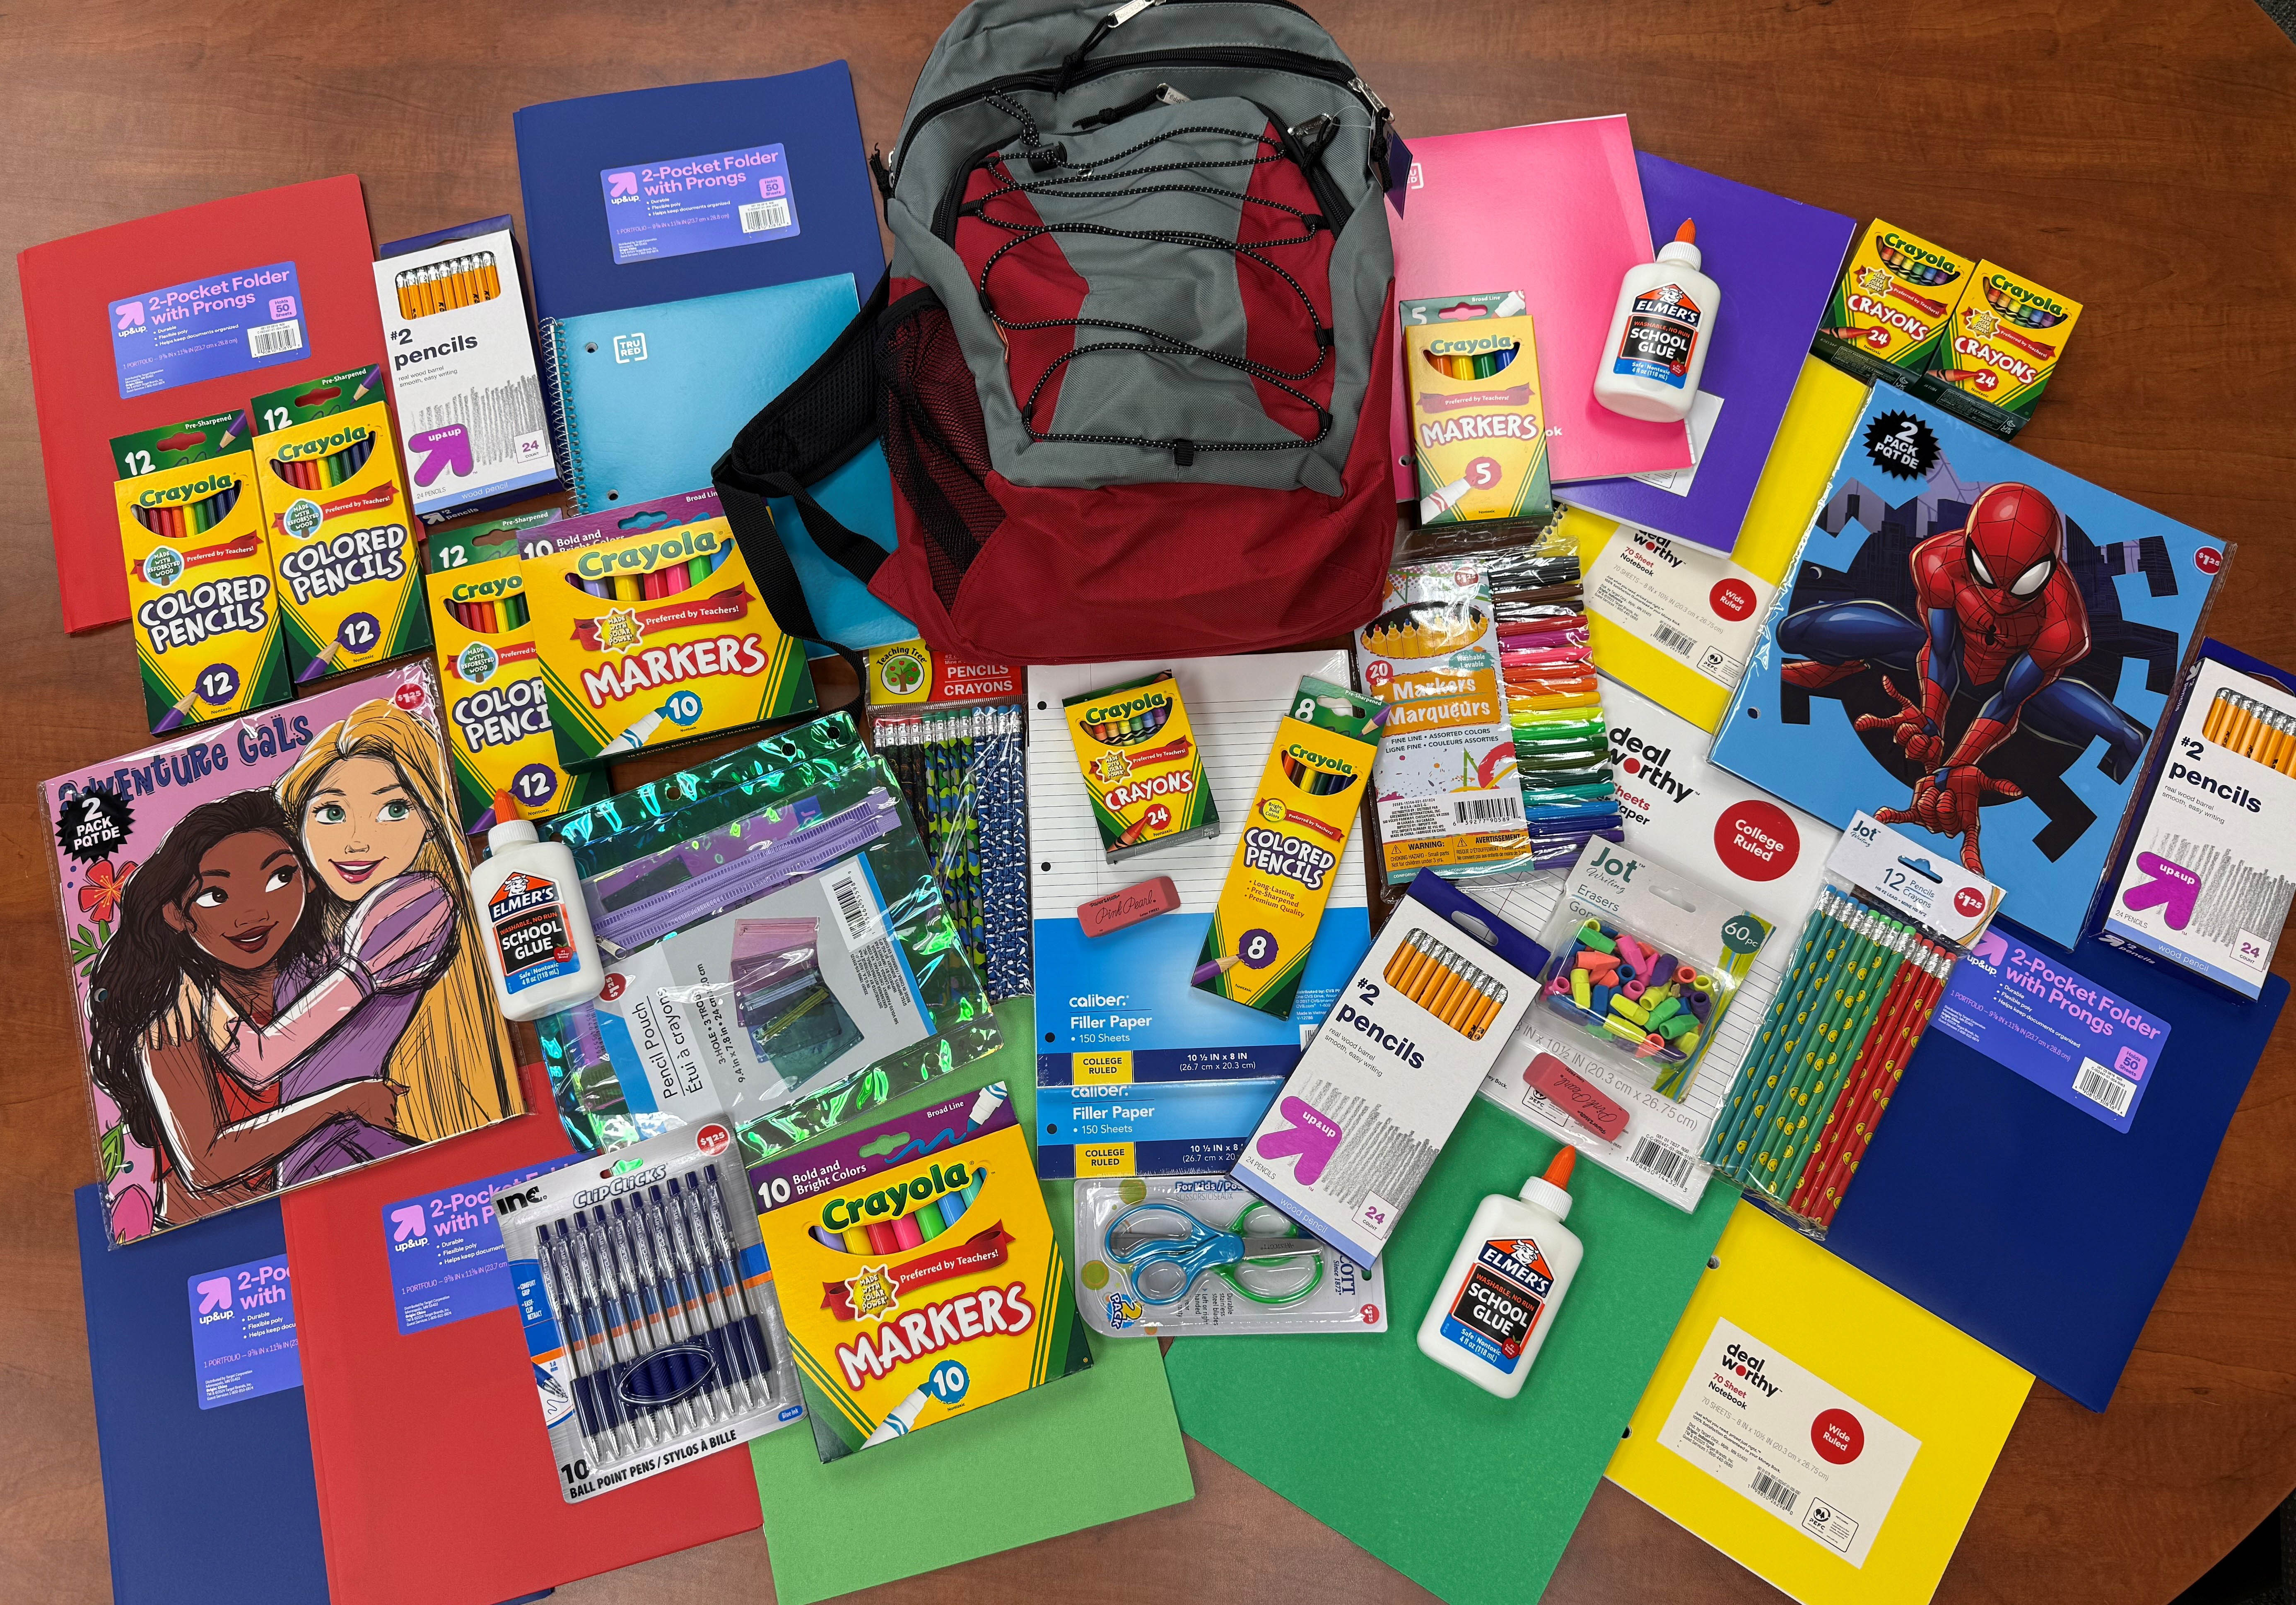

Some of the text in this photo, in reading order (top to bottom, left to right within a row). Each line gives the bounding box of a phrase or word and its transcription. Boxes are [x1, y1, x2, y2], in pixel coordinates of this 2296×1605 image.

[642, 152, 779, 183] 2-Pocket Folder
[645, 171, 746, 196] with Prongs
[611, 195, 640, 205] up&up
[1884, 232, 1957, 274] Crayola
[149, 270, 289, 310] 2-Pocket Folder
[1990, 273, 2064, 316] Crayola
[152, 293, 256, 325] with Prongs
[1412, 306, 1427, 325] 5
[1636, 300, 1699, 324] ELMER'S
[1847, 294, 1929, 342] CRAYONS
[118, 326, 147, 337] up&up
[390, 329, 413, 345] #2
[1630, 328, 1688, 352] SCHOOL
[1634, 321, 1669, 332] WASHABLE,
[1678, 330, 1690, 338] RUN
[1867, 330, 1888, 345] 24
[394, 335, 478, 371] pencils
[620, 340, 640, 348] TRU
[621, 347, 641, 356] RED
[1430, 335, 1512, 354] Crayola
[1638, 341, 1675, 359] GLUE
[1954, 336, 2037, 385] CRAYONS
[400, 378, 422, 387] smooth,
[1975, 373, 1996, 388] 24
[1445, 397, 1472, 405] Preferred
[185, 415, 232, 430] Pre-Sharpened
[428, 427, 462, 442] up&up
[1421, 414, 1537, 447] MARKERS
[1895, 422, 1918, 443] 2
[278, 424, 367, 462] Crayola
[522, 440, 539, 452] 24
[1884, 434, 1920, 457] PACK
[125, 450, 156, 475] 12
[1874, 442, 1920, 470] PQT DE
[1476, 463, 1491, 484] 5
[140, 473, 234, 507] Crayola
[424, 487, 446, 496] PENCILS
[462, 481, 509, 499] wood pencil
[186, 550, 216, 563] Preferred
[223, 545, 254, 555] Teachers!
[282, 527, 404, 577] COLORED
[439, 544, 468, 569] 12
[524, 540, 554, 559] 10
[579, 531, 718, 577] Crayola
[291, 550, 403, 602] PENCILS
[140, 578, 269, 627] COLORED
[646, 604, 739, 625] Preferred by Teachers!
[150, 602, 267, 651] PENCILS
[344, 620, 374, 645] 12
[877, 646, 926, 666] Teaching Tree
[202, 671, 232, 696] 12
[584, 636, 767, 706] MARKERS
[948, 665, 1009, 678] PENCILS
[944, 681, 1013, 696] CRAYONS
[667, 696, 699, 718] 10
[1085, 691, 1165, 723] Crayola
[1295, 699, 1316, 720] 8
[1388, 701, 1490, 725] Marqueurs
[1429, 731, 1462, 740] ASSORTED
[1609, 726, 1672, 768] deal
[1288, 744, 1354, 776] Crayola
[2180, 735, 2204, 762] #2
[1105, 771, 1194, 810] CRAYONS
[2169, 761, 2262, 814] pencils
[81, 798, 103, 822] 2
[1147, 807, 1168, 823] 24
[73, 825, 121, 851] PQT DE
[76, 816, 113, 836] PACK
[1734, 819, 1785, 853] College
[1853, 820, 1877, 842] Jot
[1244, 829, 1334, 868] COLORED
[1408, 840, 1445, 850] WARNING:
[1733, 834, 1774, 863] Ruled
[1245, 847, 1324, 888] PENCILS
[1589, 847, 1638, 884] Jot
[2159, 863, 2196, 885] up&up
[1884, 868, 1905, 892] 12
[1909, 879, 1936, 899] Pencils
[493, 887, 554, 919] ELMER'S
[1577, 884, 1620, 913] Erasers
[1902, 887, 1932, 910] Crayons
[502, 922, 562, 950] SCHOOL
[1247, 936, 1267, 960] 8
[515, 939, 553, 959] GLUE
[2241, 941, 2260, 959] 24
[1967, 954, 1997, 976] up&up
[1356, 978, 1380, 1006] #2
[2005, 966, 2114, 1037] with Prongs
[2011, 947, 2161, 1041] 2-Pocket Folder
[1071, 1016, 1152, 1030] Filler Paper
[657, 988, 703, 1094] Étui à crayons
[1079, 1033, 1130, 1043] 150 Sheets
[1337, 1004, 1425, 1069] pencils
[632, 1002, 678, 1099] Pencil Pouch
[1082, 1057, 1122, 1066] COLLEGE
[1073, 1106, 1155, 1121] Filler Paper
[1302, 1110, 1336, 1138] up&up
[792, 1161, 841, 1185] Bold and
[797, 1163, 867, 1195] Bright Colors
[758, 1178, 791, 1208] 10
[822, 1162, 970, 1231] Crayola
[433, 1217, 480, 1237] with
[1364, 1206, 1385, 1225] 24
[395, 1236, 429, 1252] up&up
[1483, 1248, 1548, 1292] ELMER'S
[199, 1309, 234, 1325] up&up
[1468, 1283, 1529, 1328] SCHOOL
[1474, 1305, 1513, 1335] GLUE
[839, 1286, 1032, 1388] MARKERS
[1461, 1328, 1501, 1356] Safe Nontoxic
[1726, 1343, 1766, 1373] deal
[933, 1368, 965, 1393] 10
[1713, 1373, 1747, 1398] 70 Sheet
[1708, 1381, 1747, 1410] Notebook
[1823, 1432, 1848, 1451] Ruled
[1829, 1423, 1850, 1442] Wide
[561, 1458, 589, 1484] 10
[569, 1429, 737, 1500] BALL POINT PENS STYLOS À BILLE
